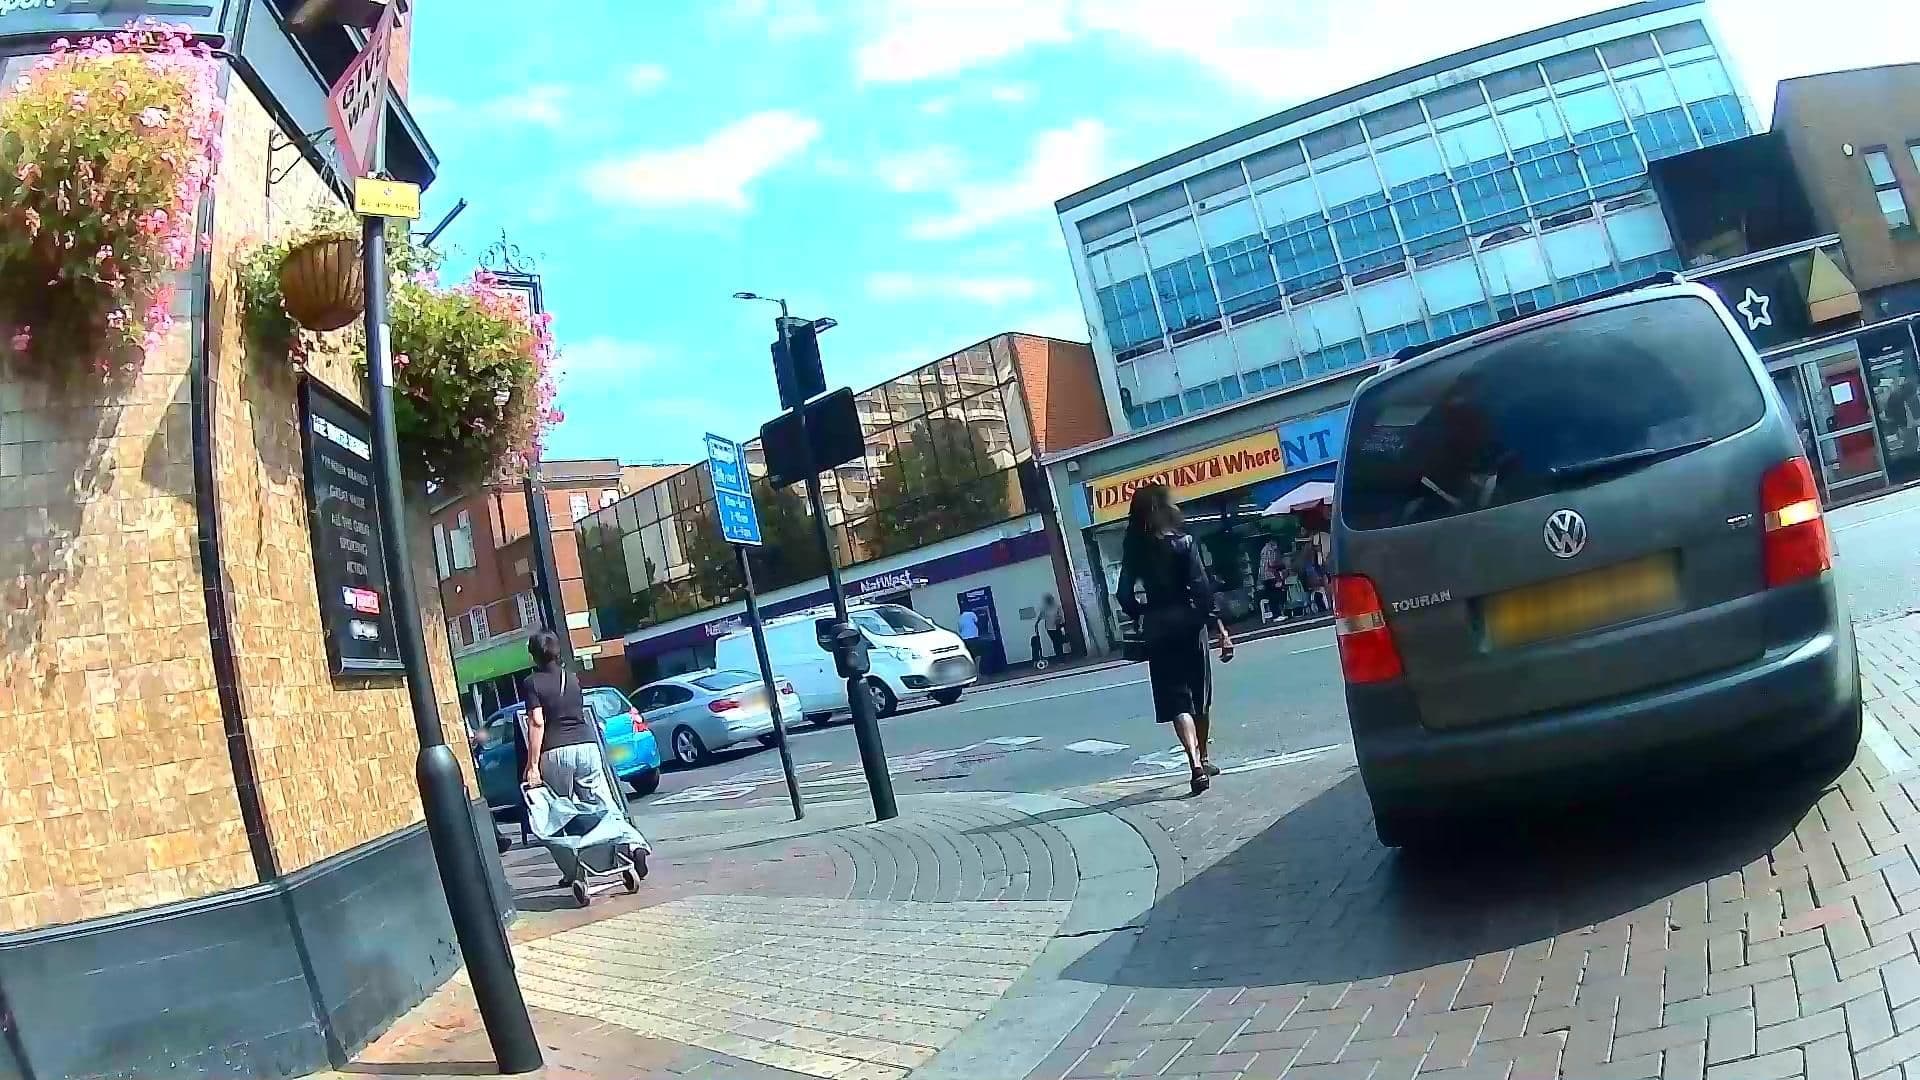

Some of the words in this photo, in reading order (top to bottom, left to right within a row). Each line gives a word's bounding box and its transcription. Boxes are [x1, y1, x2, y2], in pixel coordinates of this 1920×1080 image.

[342, 45, 383, 110] GIVE
[348, 75, 379, 130] WAY
[1223, 447, 1280, 474] Where
[860, 570, 912, 593] NatWest
[1391, 588, 1452, 612] TOURAN
